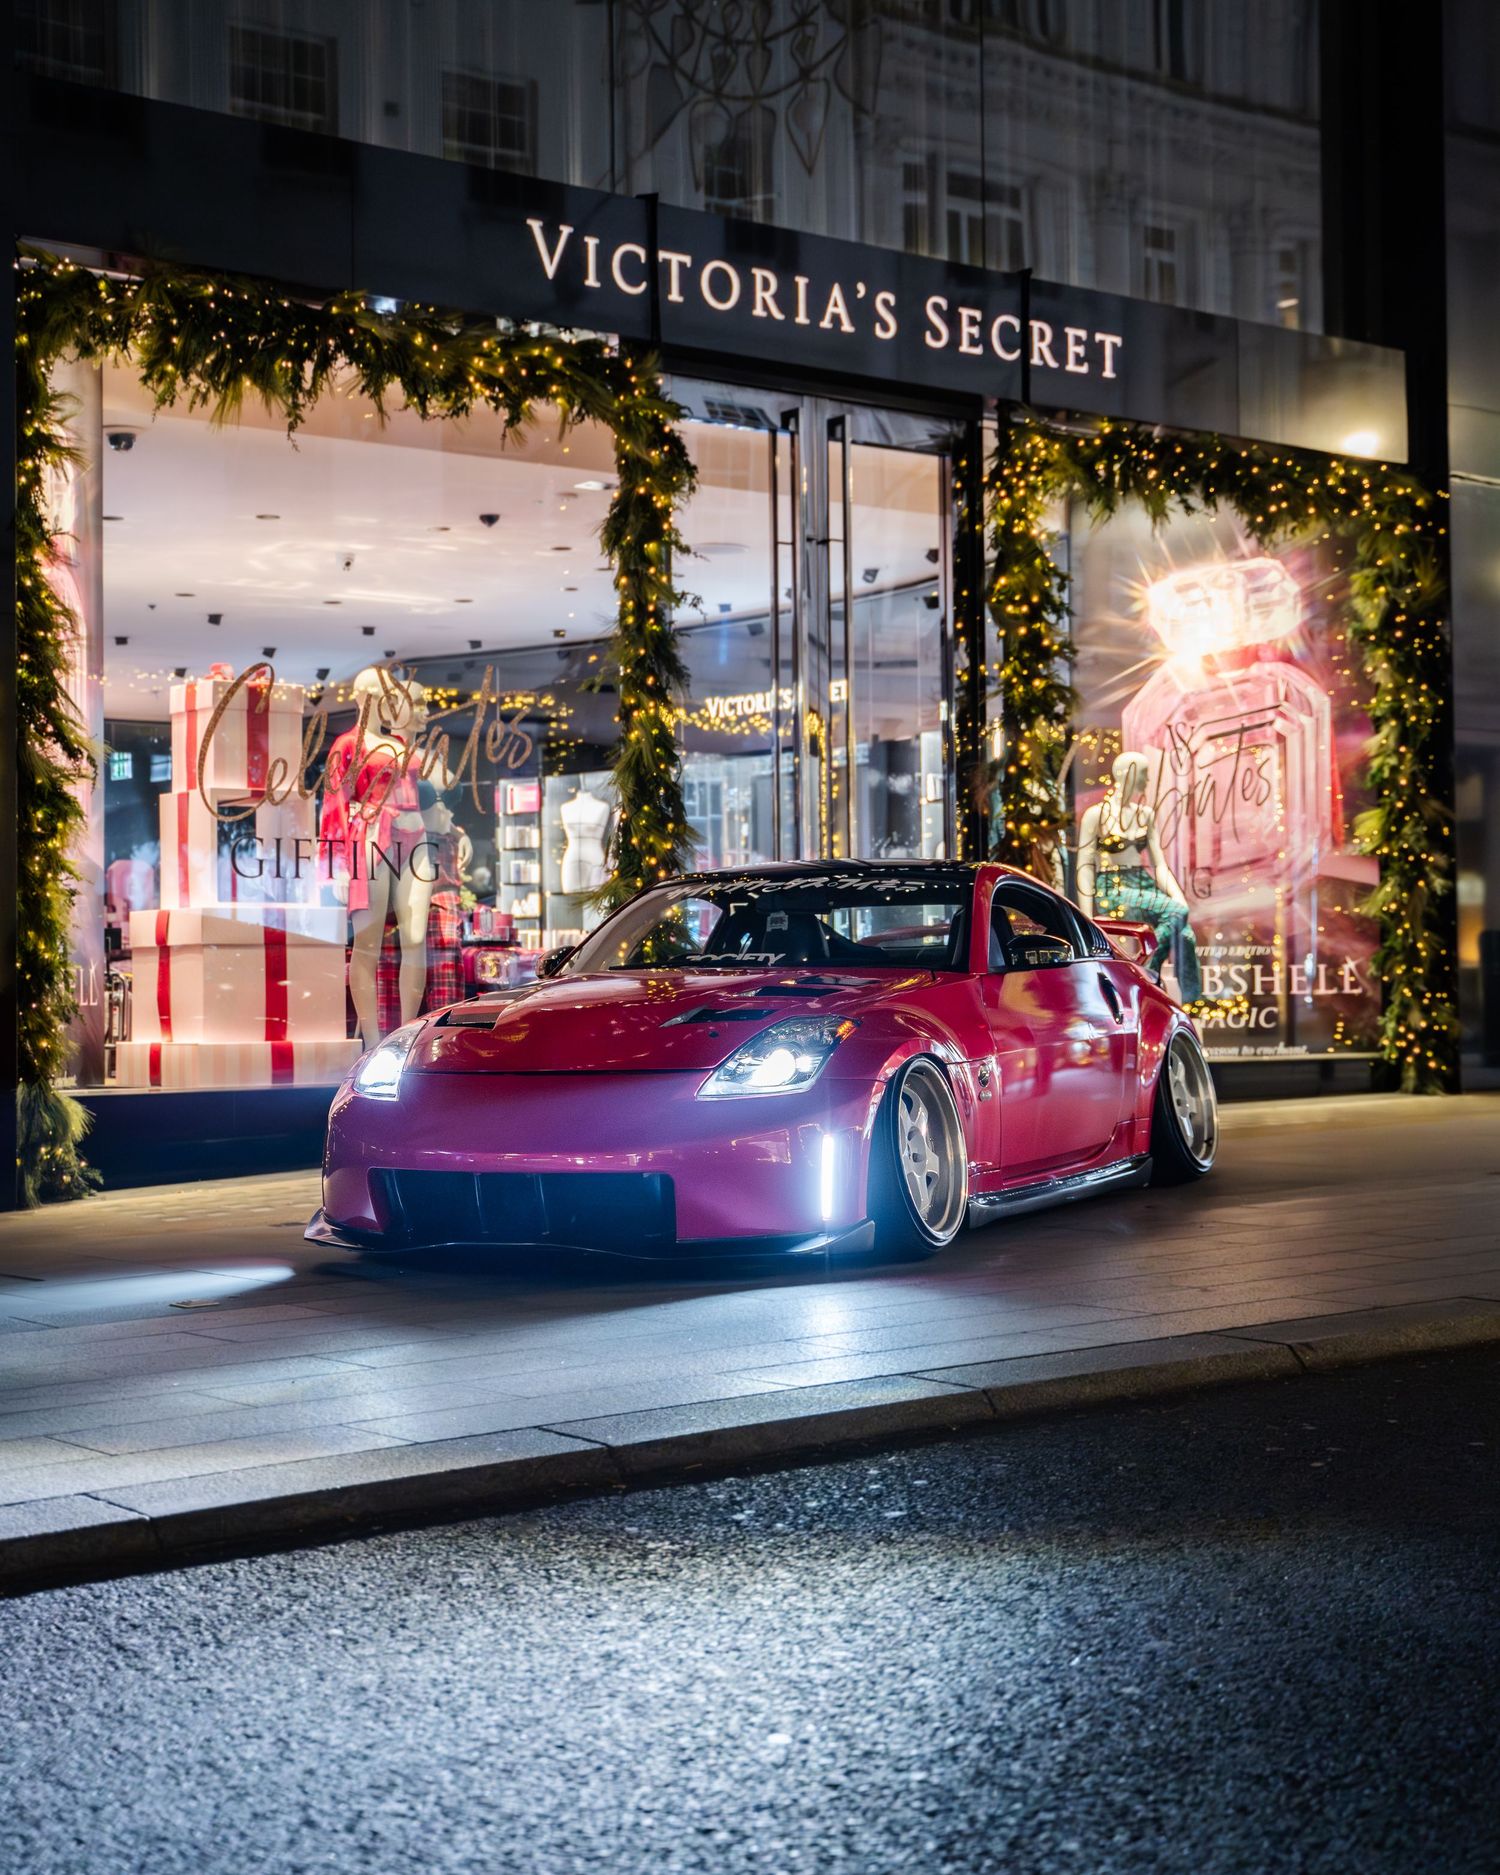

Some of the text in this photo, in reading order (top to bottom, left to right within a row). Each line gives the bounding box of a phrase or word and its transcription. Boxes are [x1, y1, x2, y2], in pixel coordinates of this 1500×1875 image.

[526, 217, 1124, 379] VICTORIA'S SECRET
[197, 661, 540, 822] Celebrates
[230, 836, 441, 884] GIFTING
[1200, 962, 1364, 996] BSHELL
[1200, 1006, 1279, 1029] AGIC
